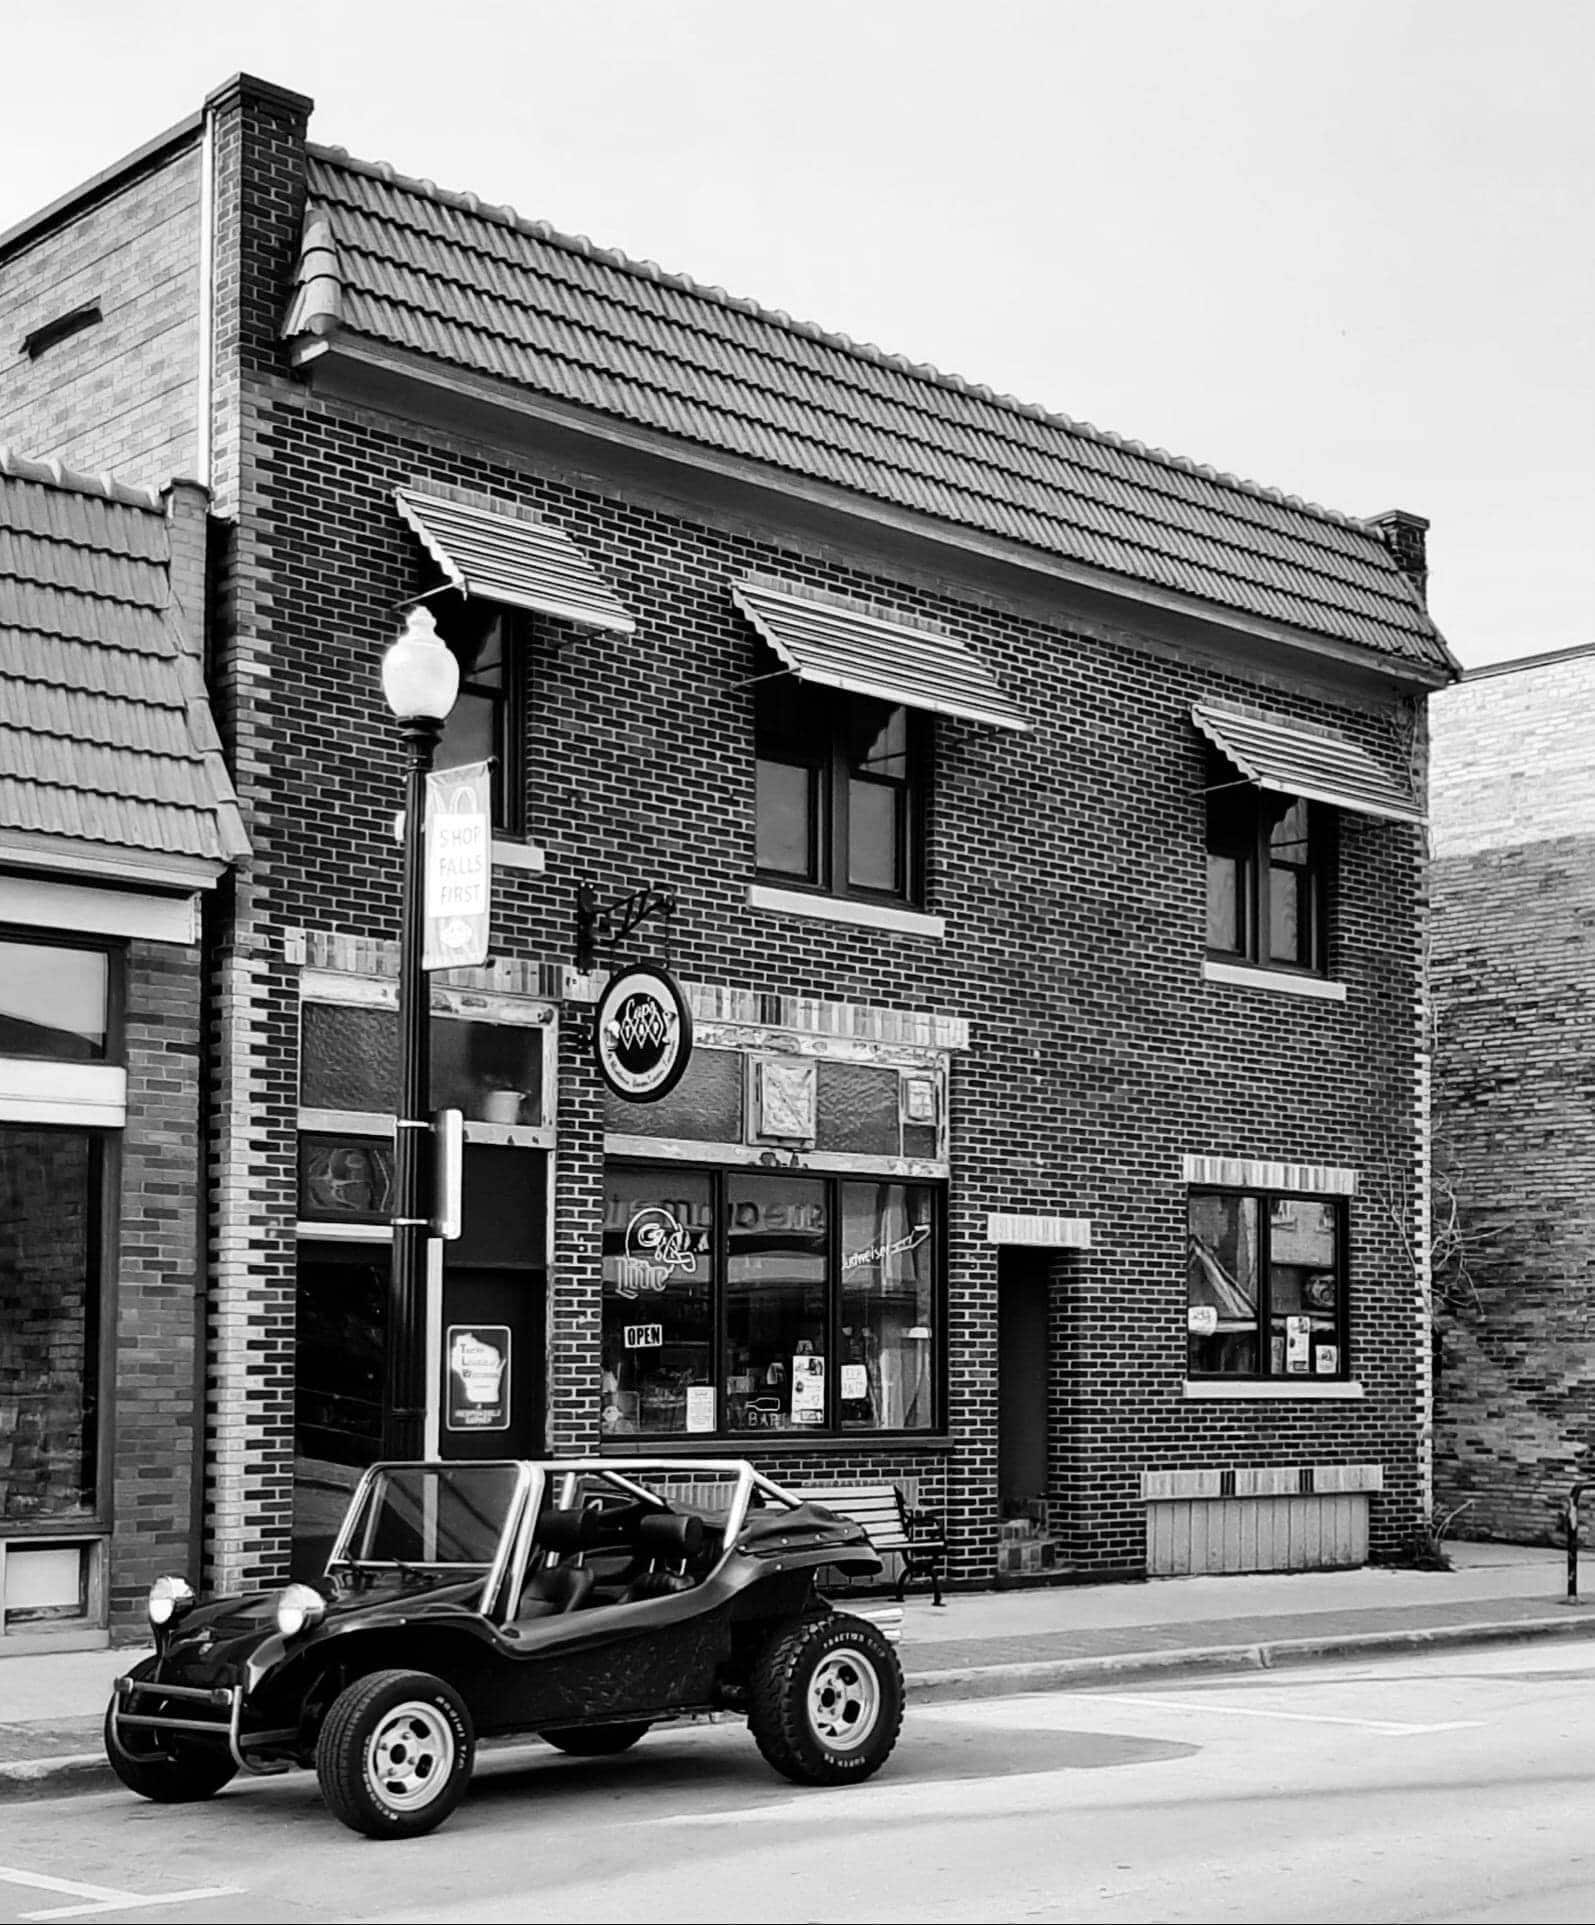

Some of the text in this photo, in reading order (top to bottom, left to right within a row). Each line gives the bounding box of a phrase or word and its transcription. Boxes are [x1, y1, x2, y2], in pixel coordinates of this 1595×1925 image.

[439, 825, 481, 848] SHOP
[439, 854, 482, 876] FALLS
[440, 883, 481, 905] FIRST
[627, 1326, 661, 1346] OPEN
[748, 1411, 781, 1427] BAR
